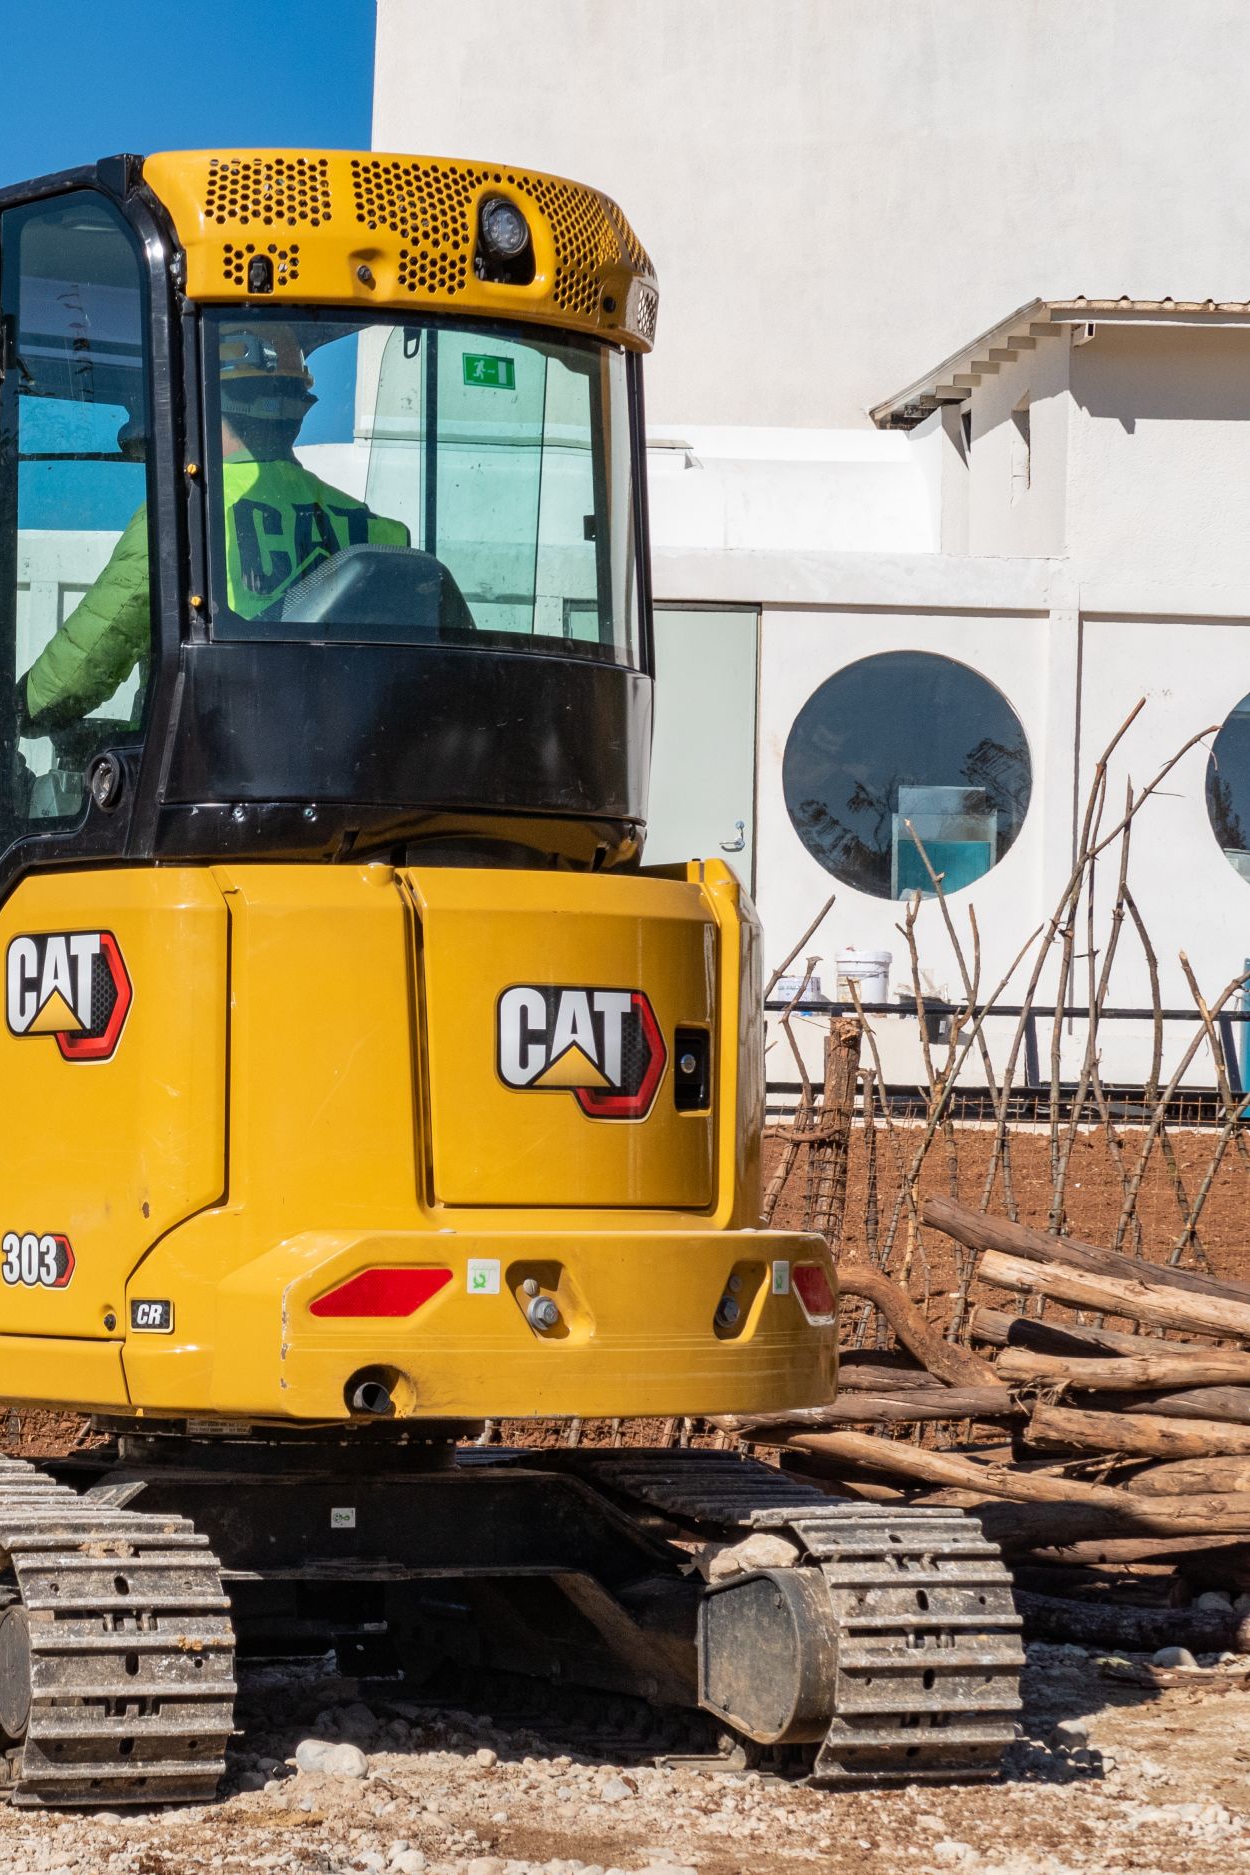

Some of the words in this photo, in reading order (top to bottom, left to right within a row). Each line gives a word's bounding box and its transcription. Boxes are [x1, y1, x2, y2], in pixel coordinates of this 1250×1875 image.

[233, 498, 378, 595] CAT
[7, 933, 101, 1033] CAT
[500, 987, 632, 1088] CAT
[2, 1232, 58, 1286] 303
[136, 1304, 163, 1325] CR
